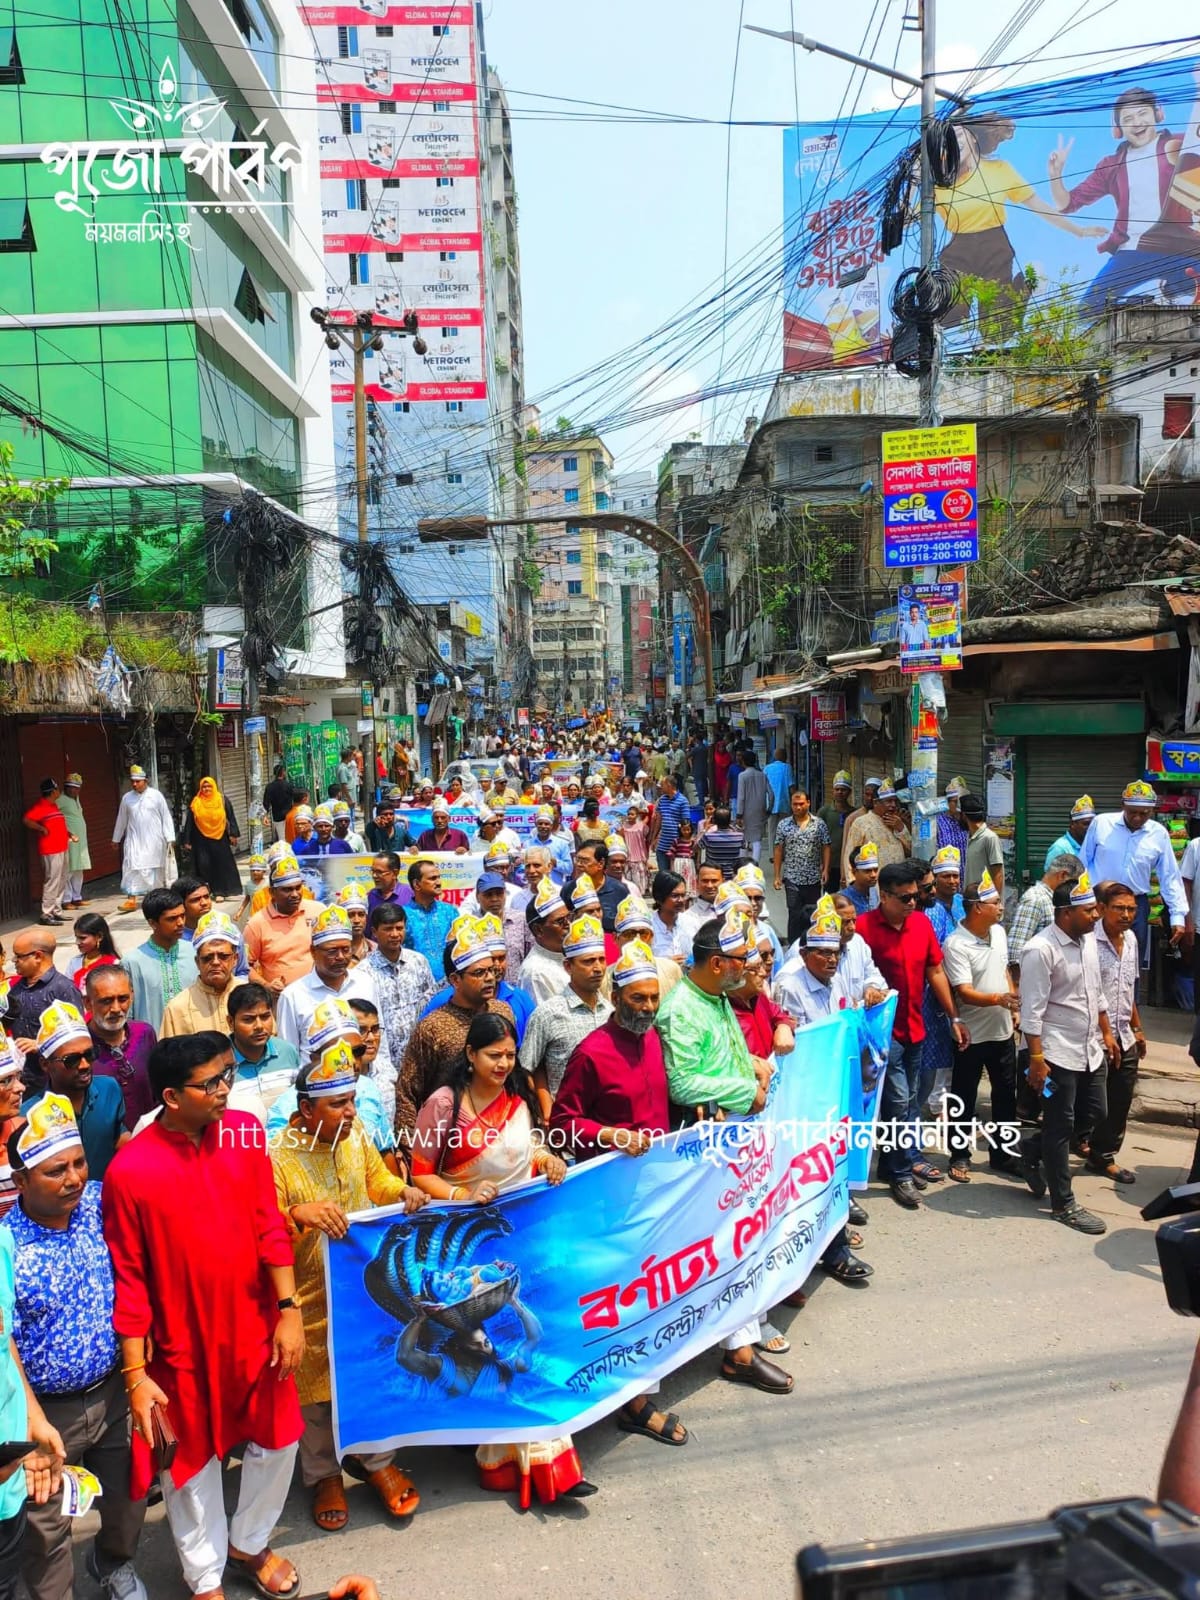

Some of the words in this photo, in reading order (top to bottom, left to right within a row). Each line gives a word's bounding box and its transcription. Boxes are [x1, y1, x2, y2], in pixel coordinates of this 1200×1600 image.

[411, 58, 460, 66] METROCEM
[418, 208, 466, 216] METROCEM
[926, 448, 952, 456] N5/N4
[886, 461, 925, 481] সেনপাই
[927, 457, 972, 477] জাপানিজ
[900, 540, 972, 554] 01979-400-600
[900, 550, 972, 562] 01918-200-100
[579, 1235, 719, 1330] বর্ণাঢ্য
